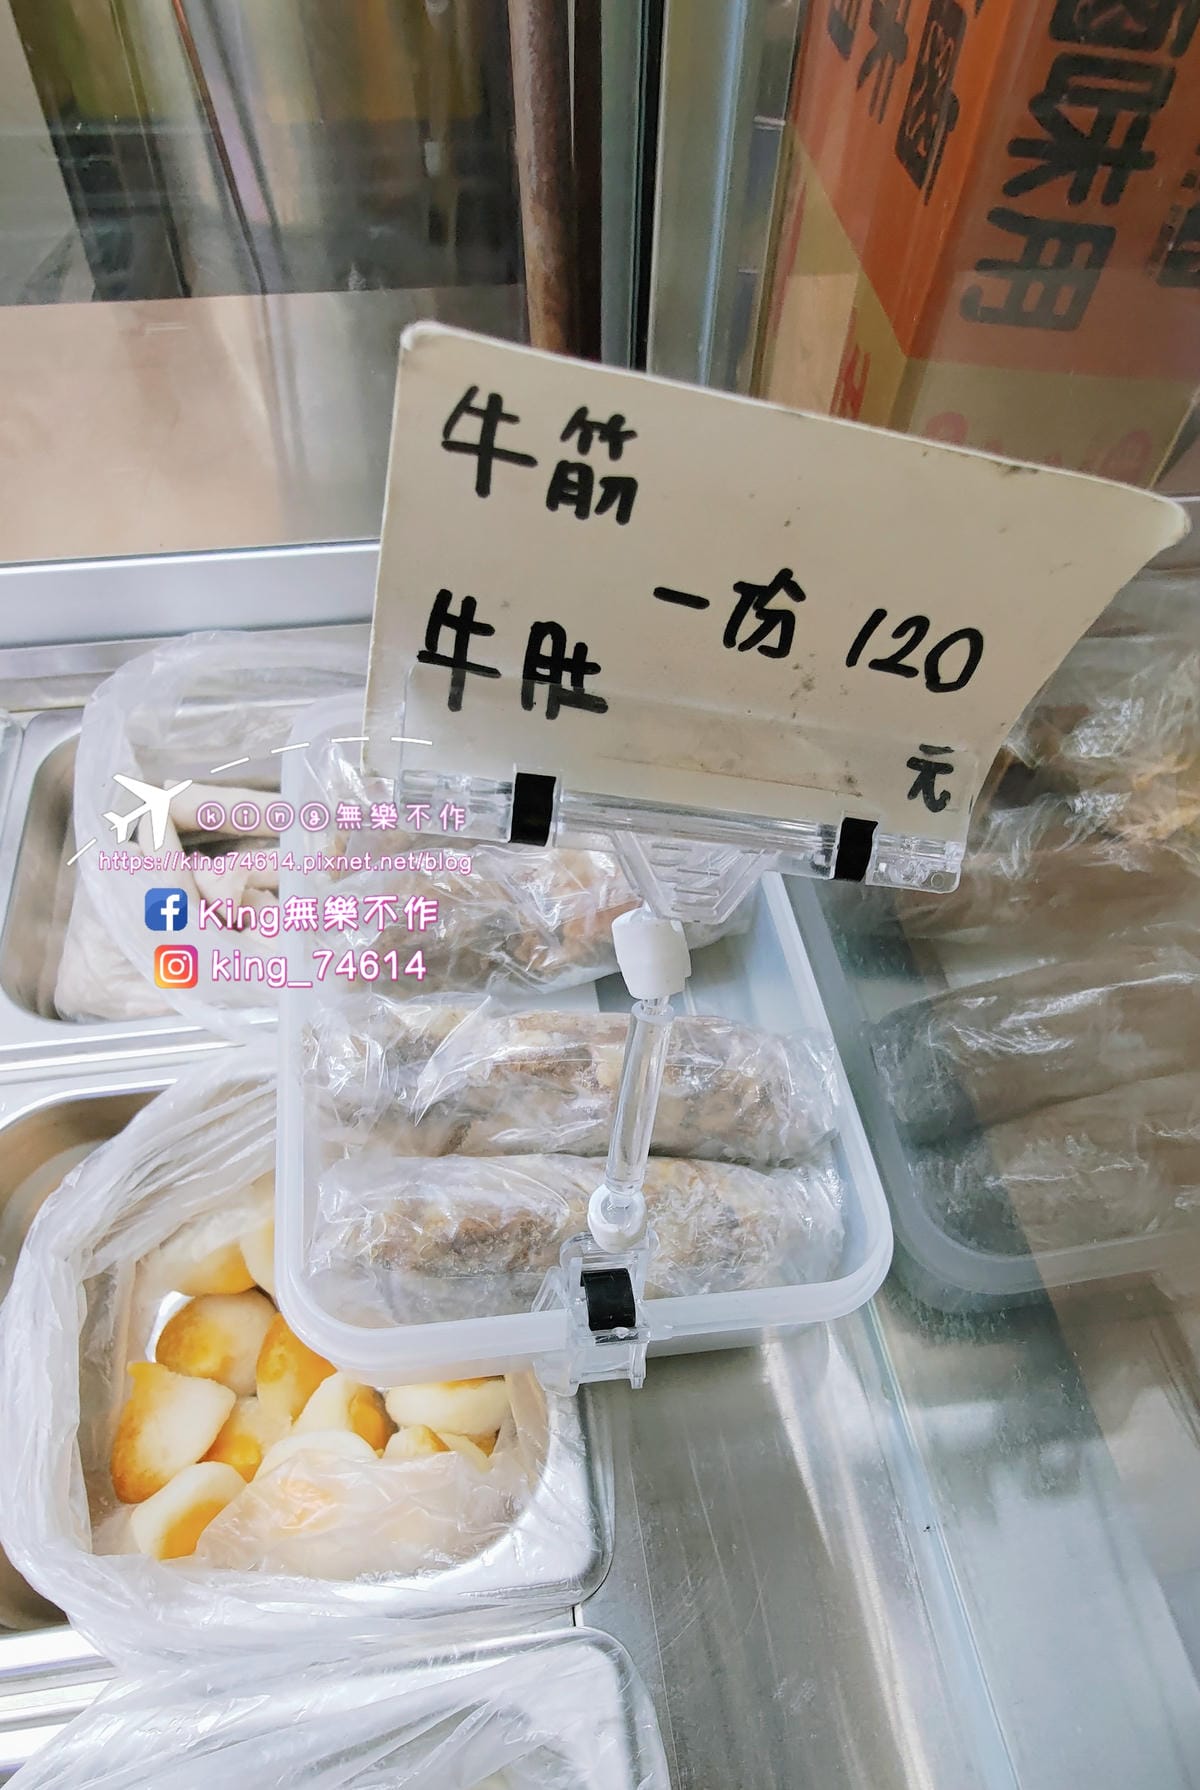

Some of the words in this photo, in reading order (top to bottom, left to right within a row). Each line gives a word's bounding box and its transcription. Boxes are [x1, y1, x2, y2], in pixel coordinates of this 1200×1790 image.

[441, 385, 639, 526] 牛筋
[416, 588, 610, 721] 牛肚
[653, 567, 806, 660] 一份
[845, 608, 984, 694] 120
[905, 744, 955, 814] 元
